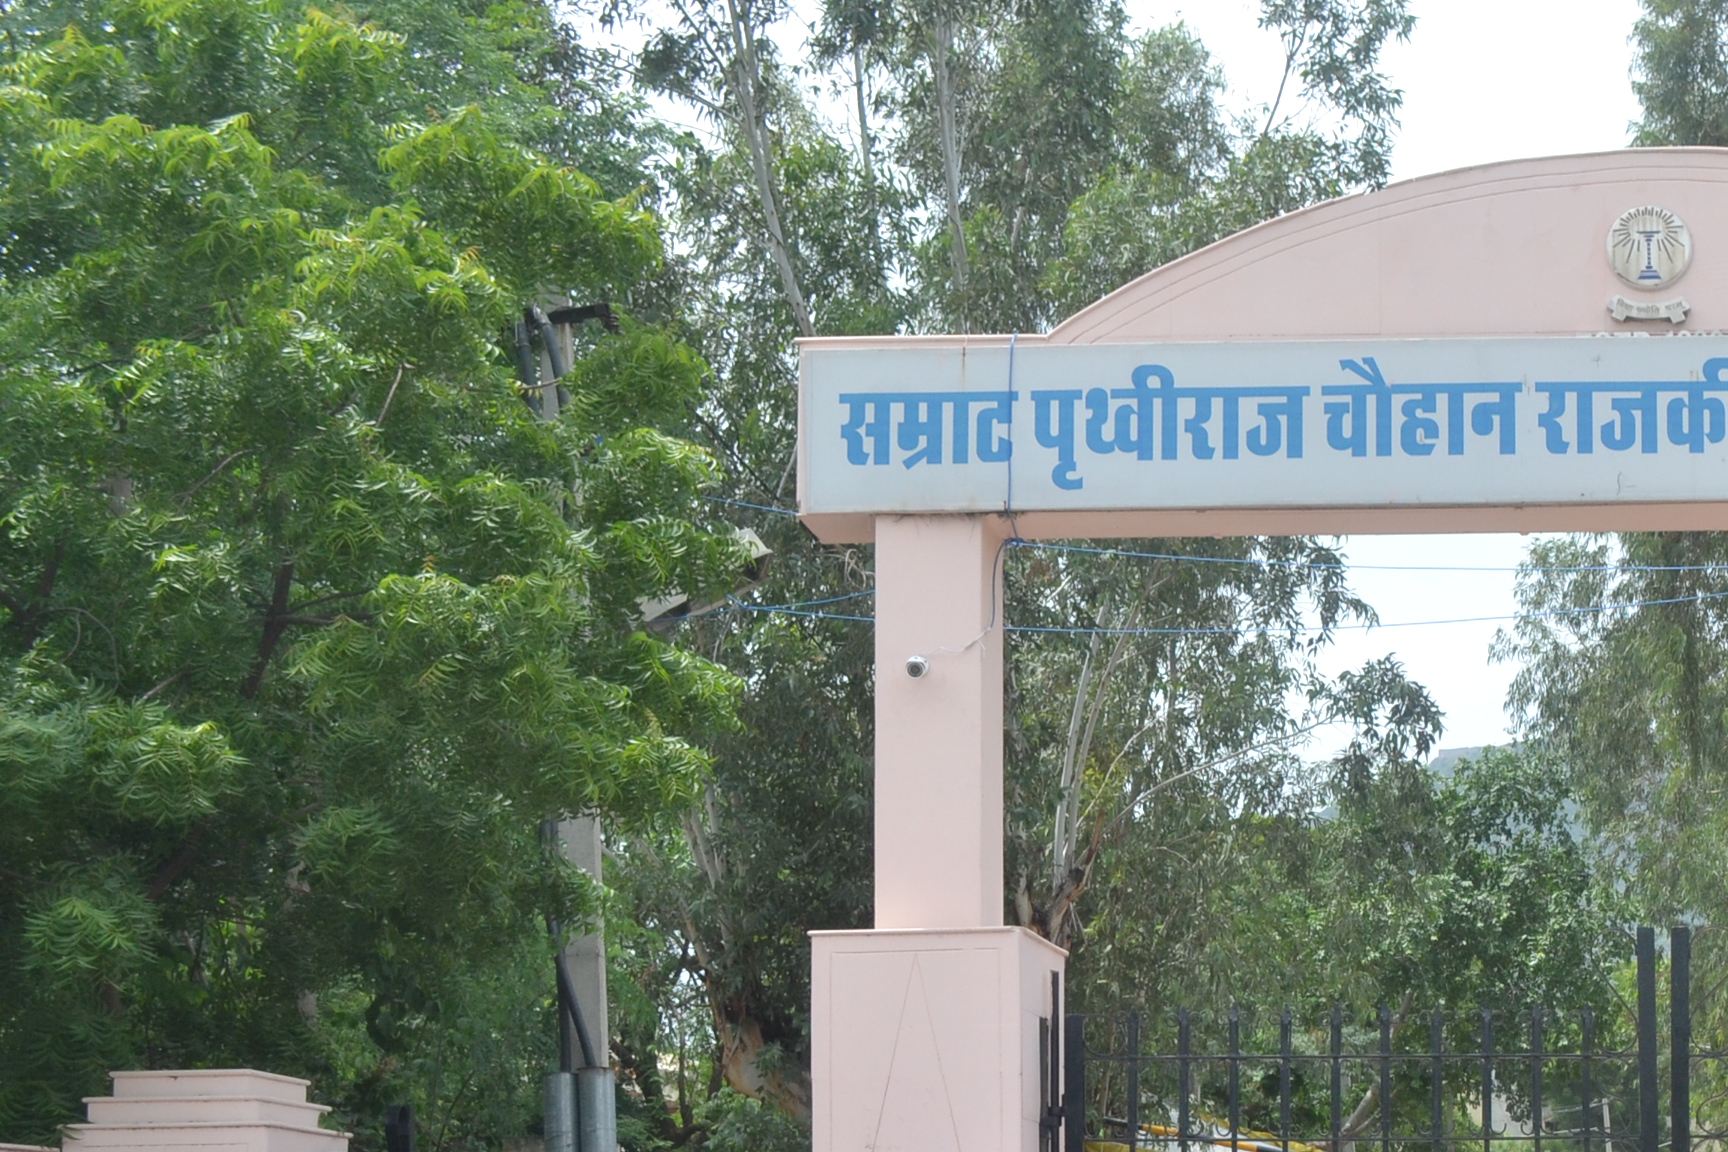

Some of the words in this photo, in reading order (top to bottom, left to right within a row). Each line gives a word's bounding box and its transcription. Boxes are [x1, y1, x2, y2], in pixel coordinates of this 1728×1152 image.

[839, 390, 1018, 471] सम्राट
[1031, 364, 1311, 491] पृथ्वीराज
[1320, 356, 1523, 458] चौहान
